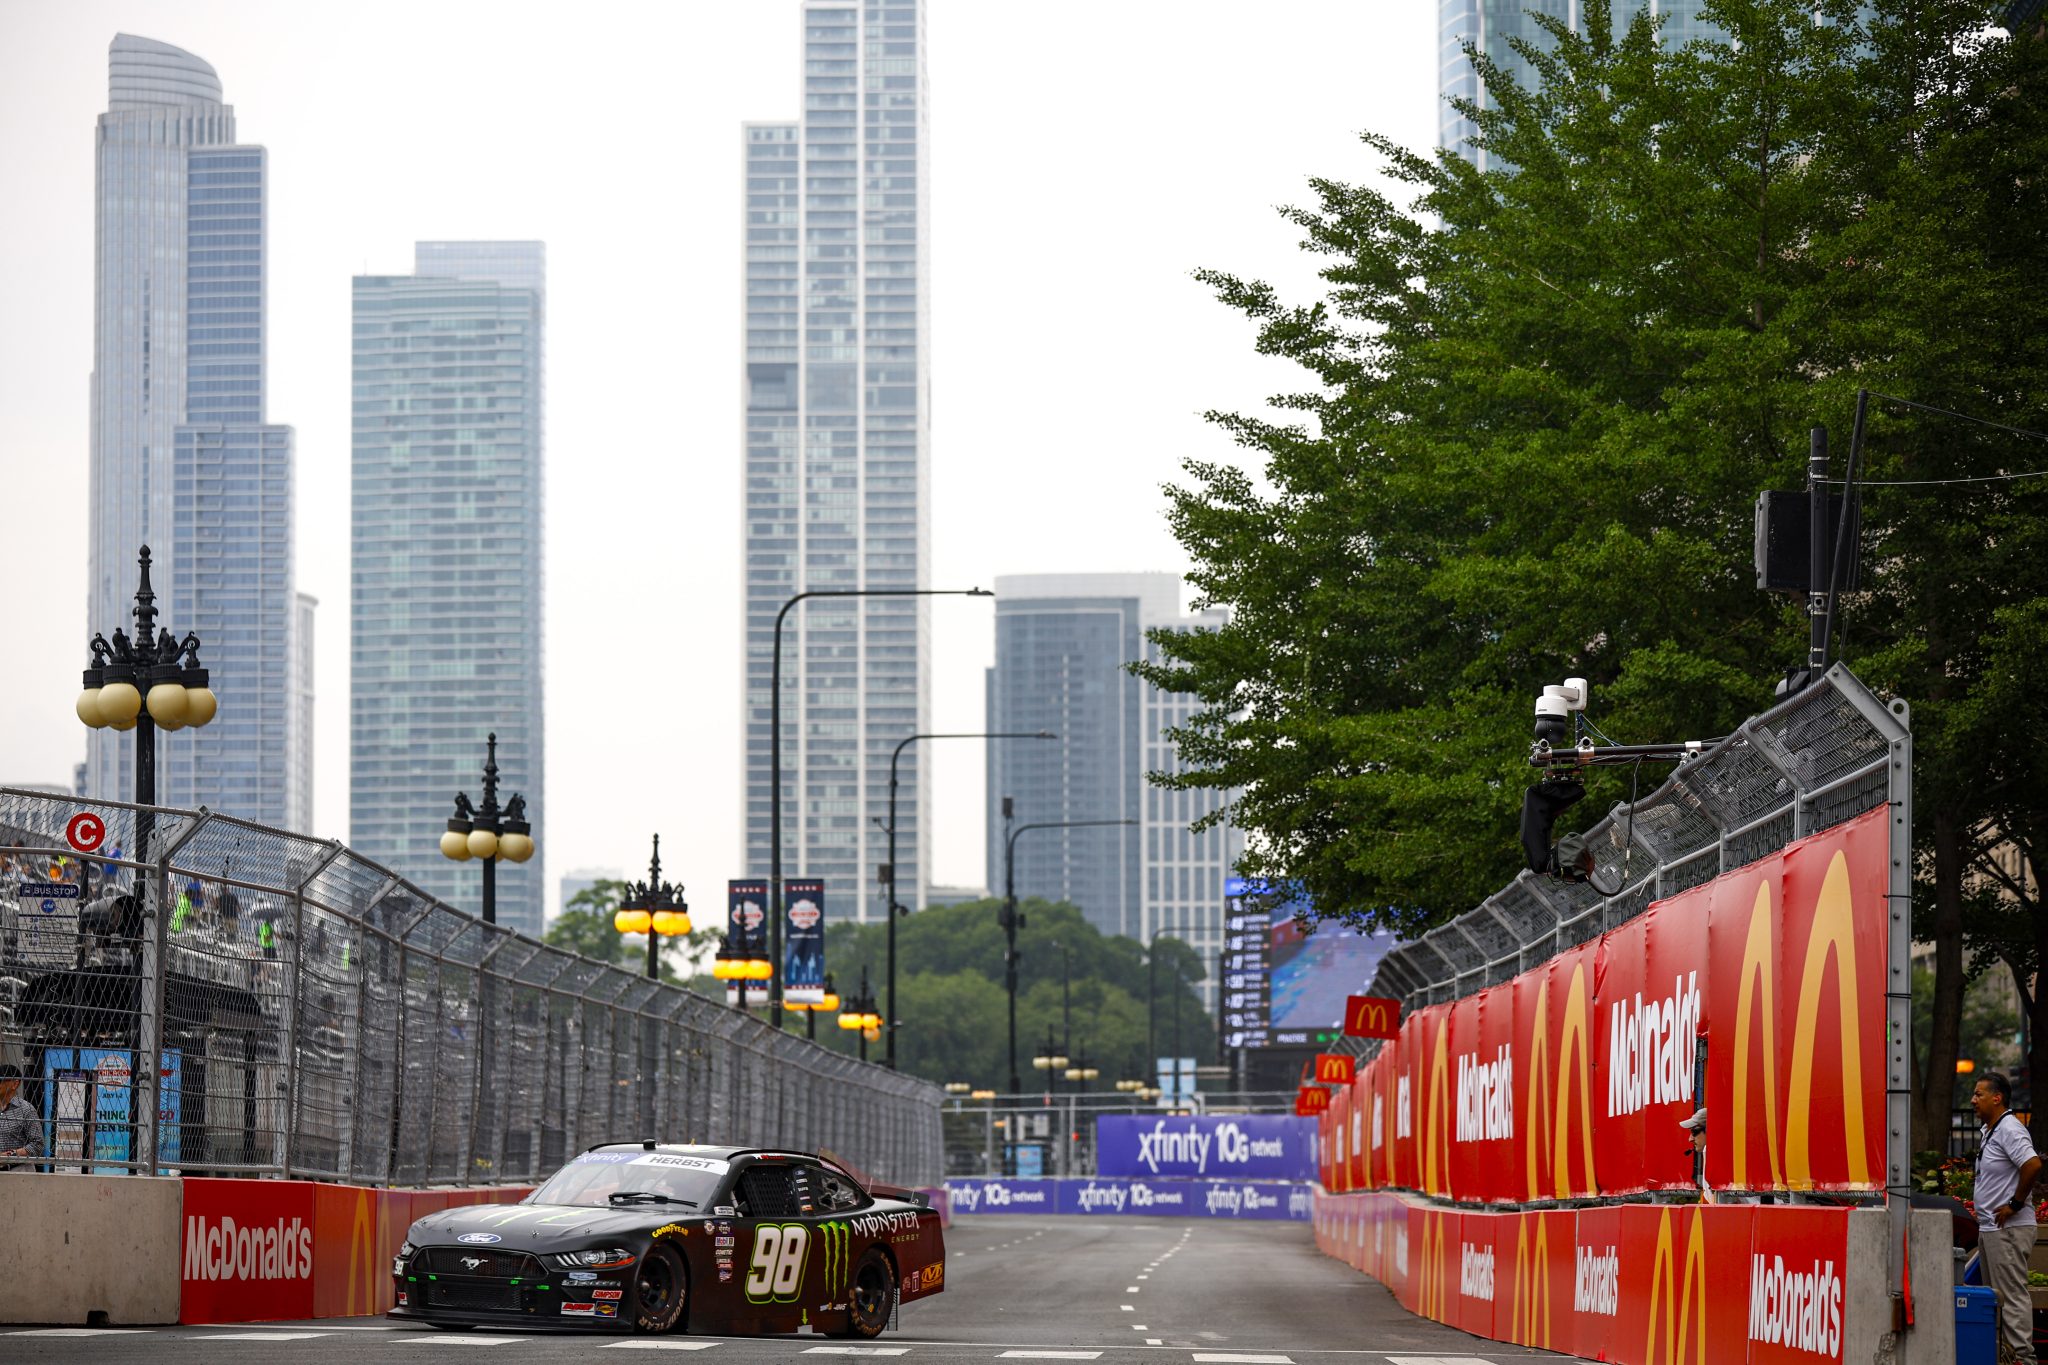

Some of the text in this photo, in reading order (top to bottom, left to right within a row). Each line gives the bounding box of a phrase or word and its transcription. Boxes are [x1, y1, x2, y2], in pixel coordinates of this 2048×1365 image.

[34, 887, 51, 895] BUS
[1138, 1119, 1211, 1174] xfinity
[1250, 1137, 1284, 1158] network
[650, 1155, 716, 1169] HERBST
[1011, 1190, 1045, 1203] network
[1078, 1182, 1128, 1212] xfinity
[652, 1223, 689, 1238] GOODYEAR
[851, 1210, 920, 1239] MONSTER
[184, 1215, 312, 1281] McDonald's
[891, 1234, 920, 1244] ENERGY
[746, 1225, 809, 1299] 98
[1574, 1245, 1619, 1317] McDonald's
[594, 1290, 621, 1299] SIMPSON
[1957, 1299, 1967, 1307] 64
[1749, 1253, 1841, 1359] McDonald's
